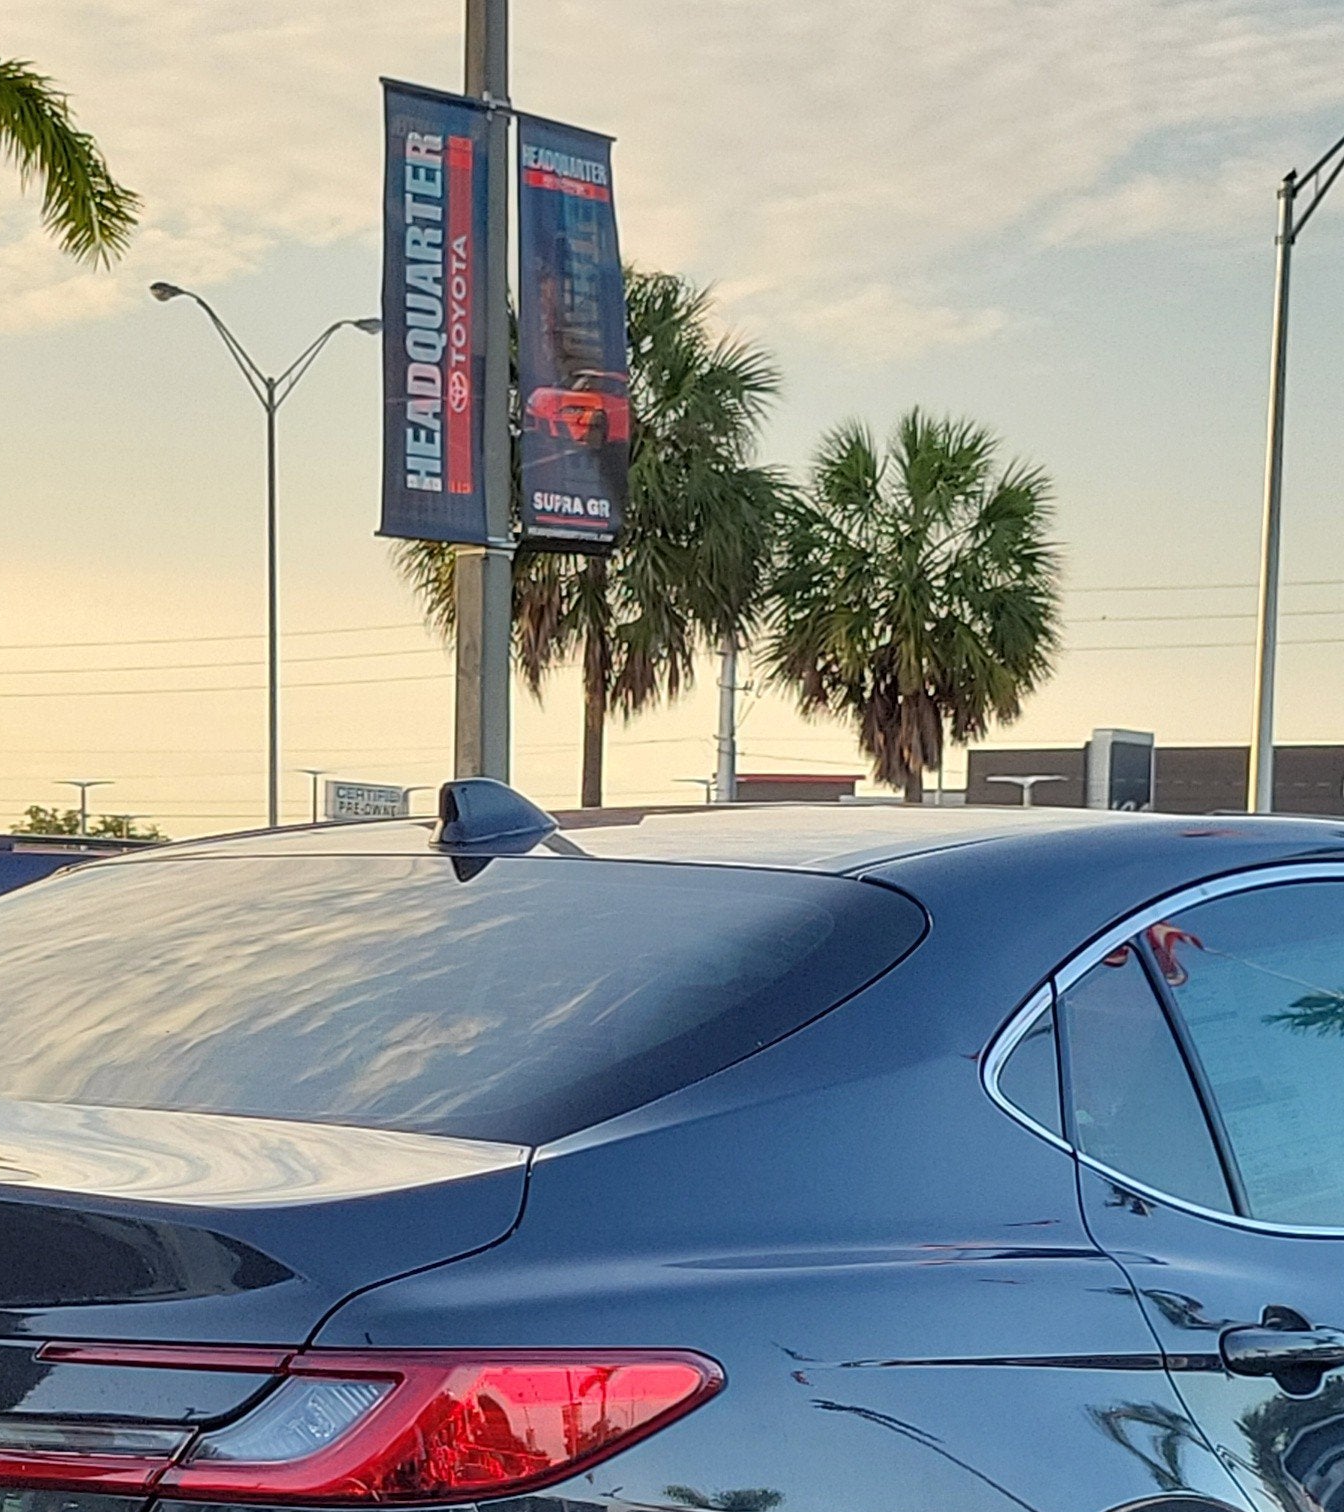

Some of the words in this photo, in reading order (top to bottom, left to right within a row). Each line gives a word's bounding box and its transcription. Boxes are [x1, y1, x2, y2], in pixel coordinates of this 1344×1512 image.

[405, 131, 447, 492] HEADQUARTER
[451, 235, 467, 368] TOYOTA
[586, 498, 610, 518] GR
[337, 786, 404, 803] CERTIFIE
[339, 801, 405, 817] PRE-OWNE
